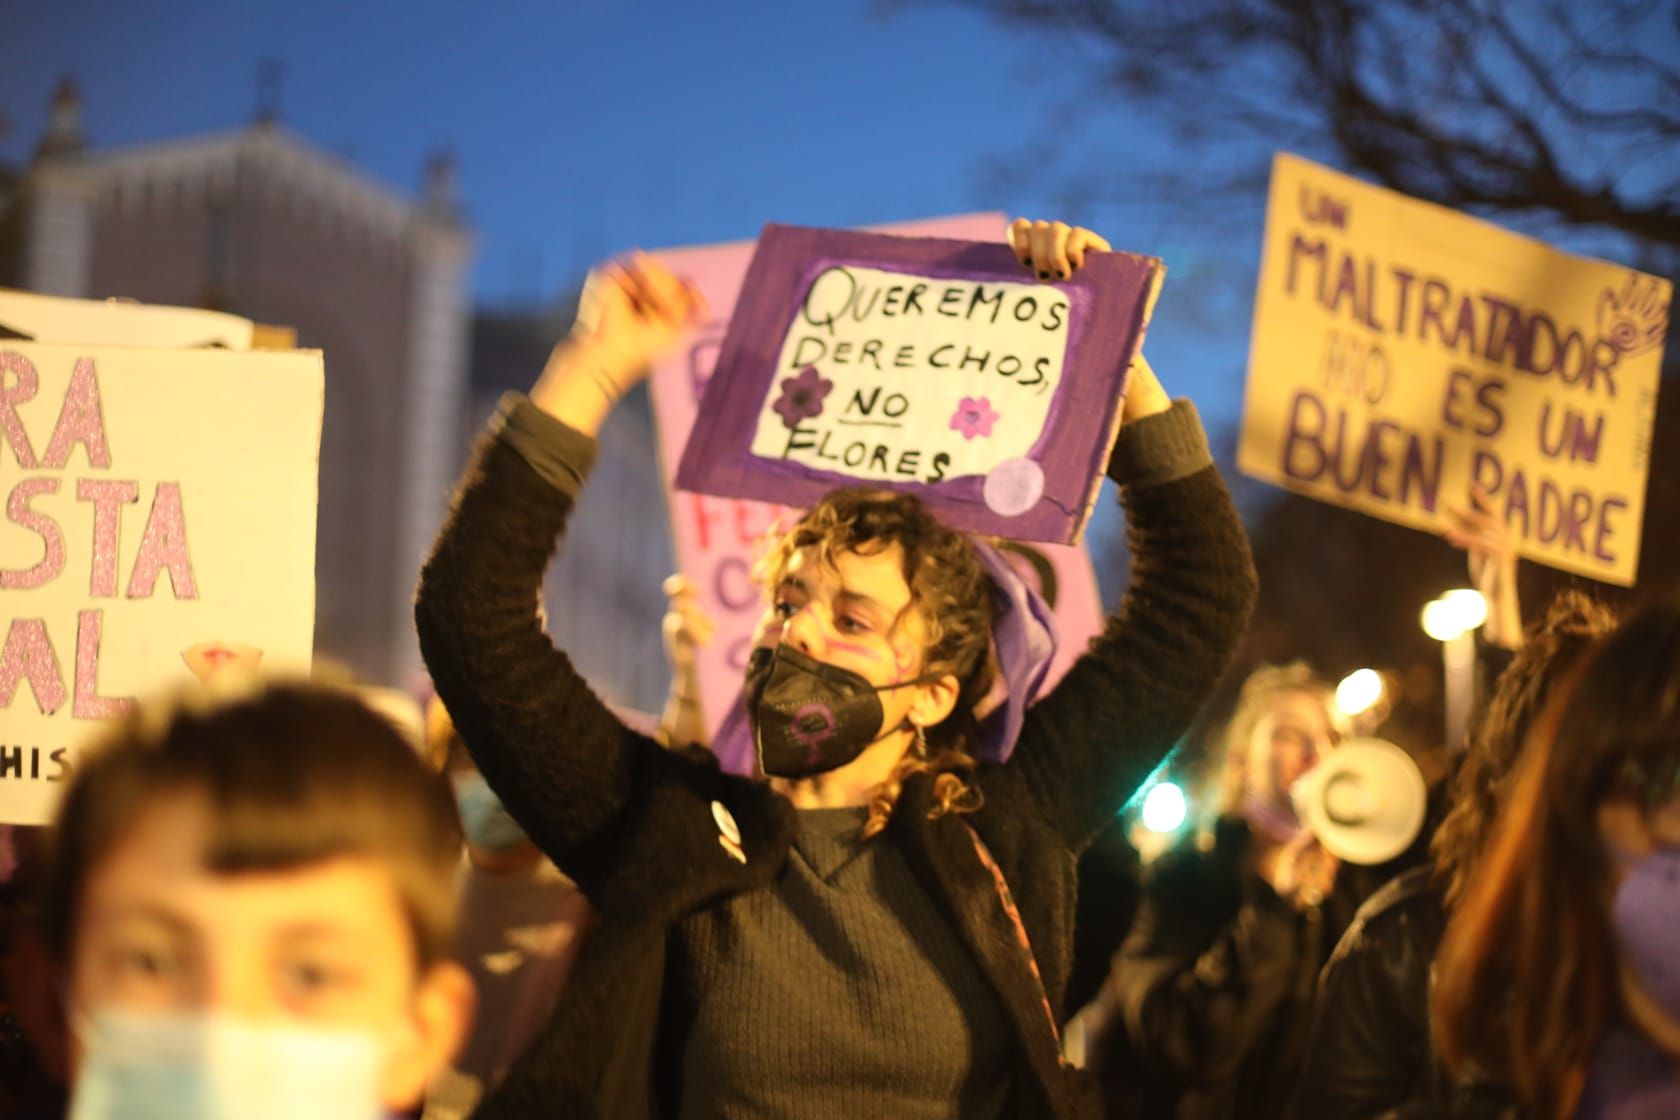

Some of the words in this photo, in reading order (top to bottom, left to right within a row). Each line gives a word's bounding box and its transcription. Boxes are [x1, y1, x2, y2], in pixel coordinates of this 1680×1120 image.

[1299, 184, 1348, 230] UN
[803, 266, 1068, 335] QUEREMOS
[791, 337, 1051, 396] DERECHOS,
[846, 387, 909, 418] NO
[1441, 371, 1504, 438] ES
[1538, 402, 1604, 463] UN
[783, 428, 951, 484] FLORES
[1280, 391, 1444, 514] BUEN
[1470, 451, 1628, 563] PADRE
